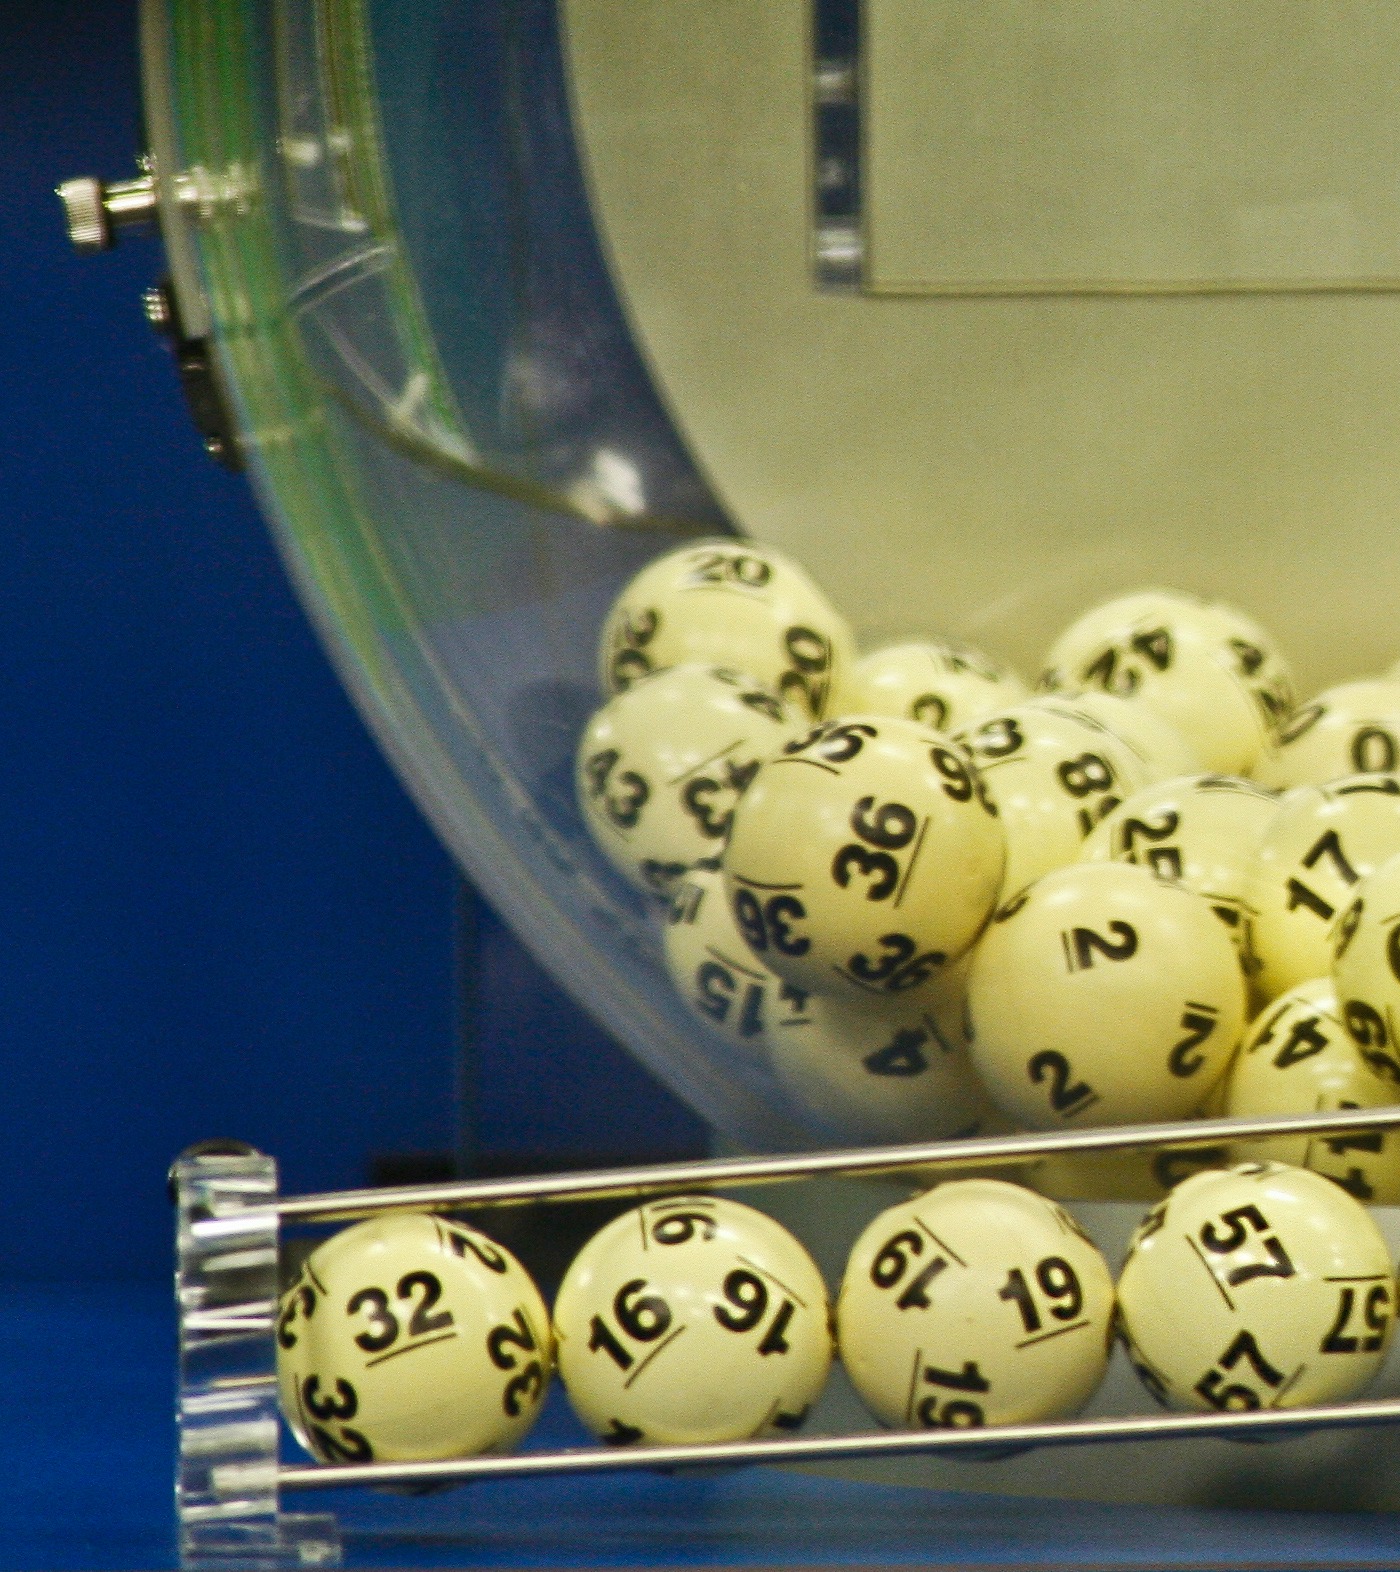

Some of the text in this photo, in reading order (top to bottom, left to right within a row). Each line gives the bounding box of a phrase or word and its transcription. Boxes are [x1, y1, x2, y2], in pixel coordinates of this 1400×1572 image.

[698, 554, 772, 588] 20
[1085, 628, 1174, 698] 42
[782, 721, 878, 763] 36
[586, 748, 650, 829] 43
[831, 796, 917, 902] 36
[1287, 830, 1359, 921] 17
[733, 888, 812, 958] 36
[847, 932, 948, 992] 36
[1065, 919, 1139, 971] 2
[695, 961, 766, 1038] 15
[1027, 1050, 1096, 1114] 2
[1166, 1011, 1218, 1079] 2
[448, 1230, 507, 1275] 2
[869, 1230, 950, 1311] 19
[1200, 1203, 1296, 1288] 57
[346, 1269, 456, 1353] 32
[588, 1278, 673, 1372] 16
[713, 1269, 796, 1358] 16
[998, 1255, 1083, 1334] 19
[1320, 1285, 1391, 1354] 57
[486, 1308, 543, 1419] 32
[916, 1360, 991, 1429] 19
[1193, 1329, 1286, 1411] 57
[302, 1374, 376, 1465] 32
